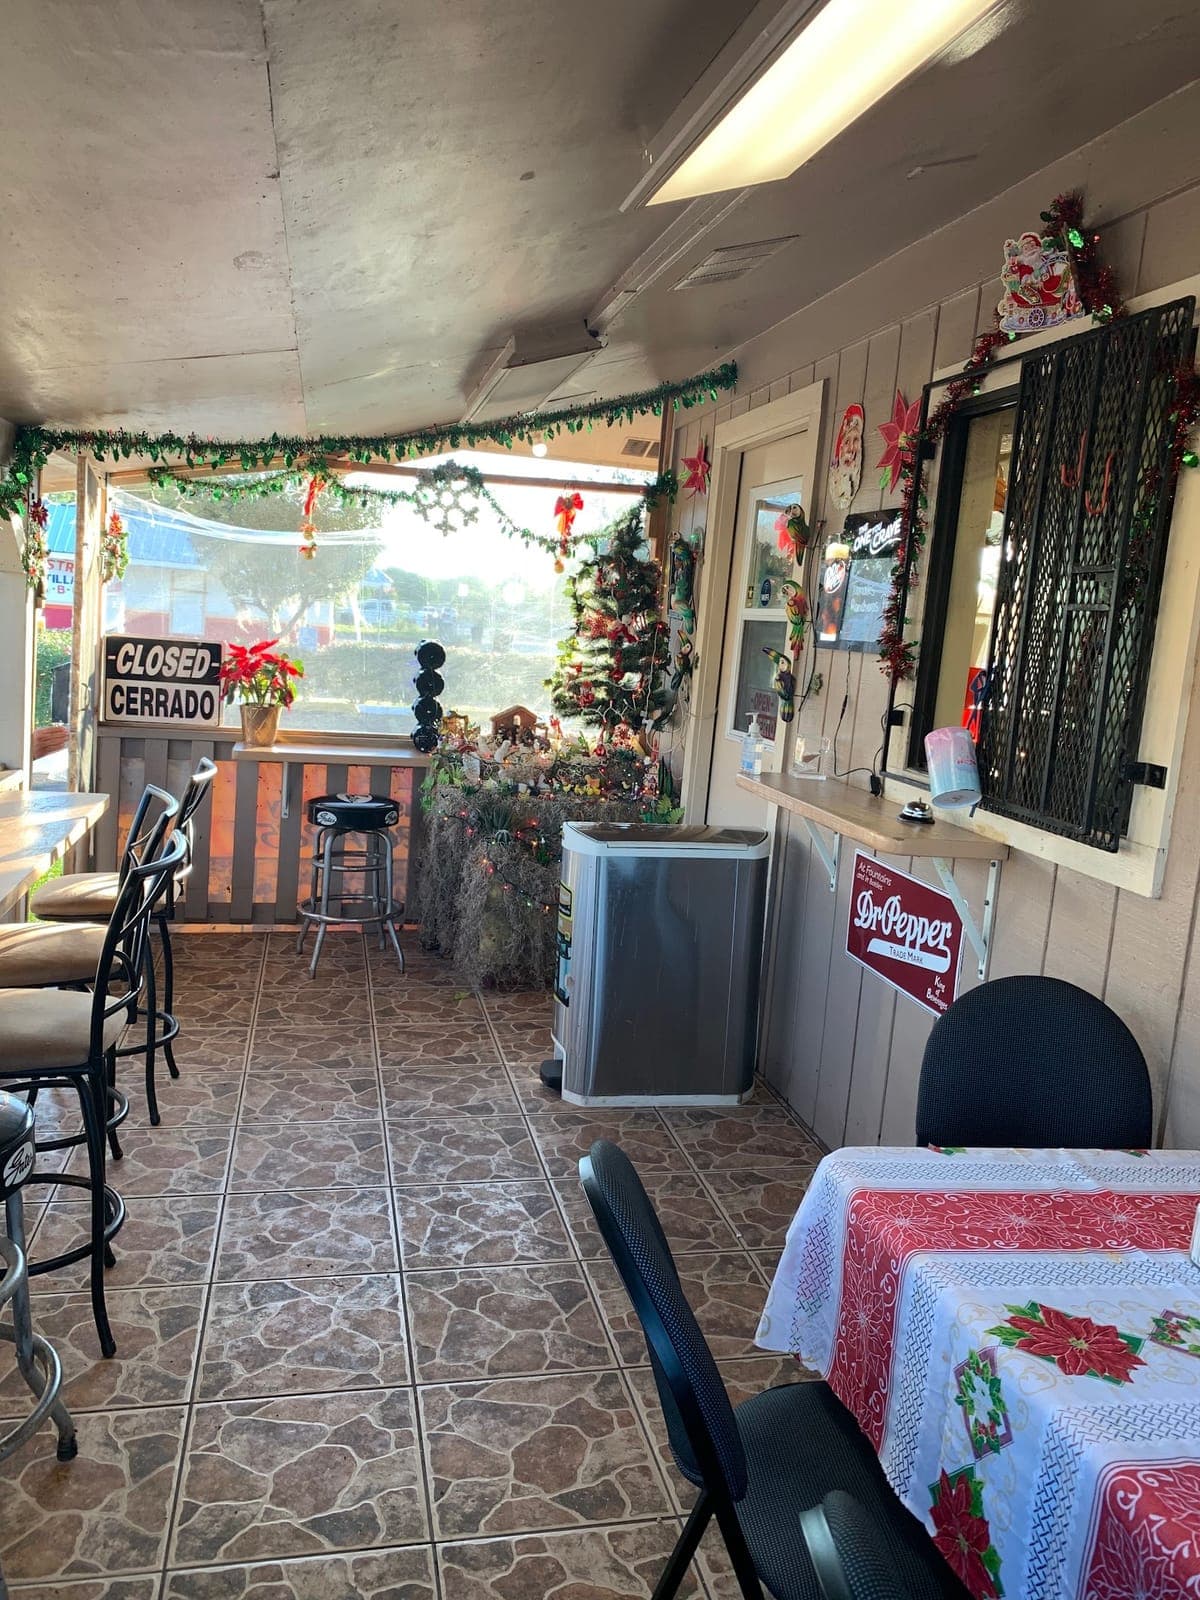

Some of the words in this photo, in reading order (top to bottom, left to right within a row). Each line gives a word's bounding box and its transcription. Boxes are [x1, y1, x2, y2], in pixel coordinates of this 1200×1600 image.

[853, 528, 872, 552] ONE
[870, 518, 902, 549] CRAVE
[110, 684, 215, 720] CERRADO
[865, 865, 892, 887] Fountains
[854, 890, 883, 931] Dr
[881, 895, 952, 952] Pepper
[889, 946, 907, 961] TRADE
[906, 952, 924, 965] MARK
